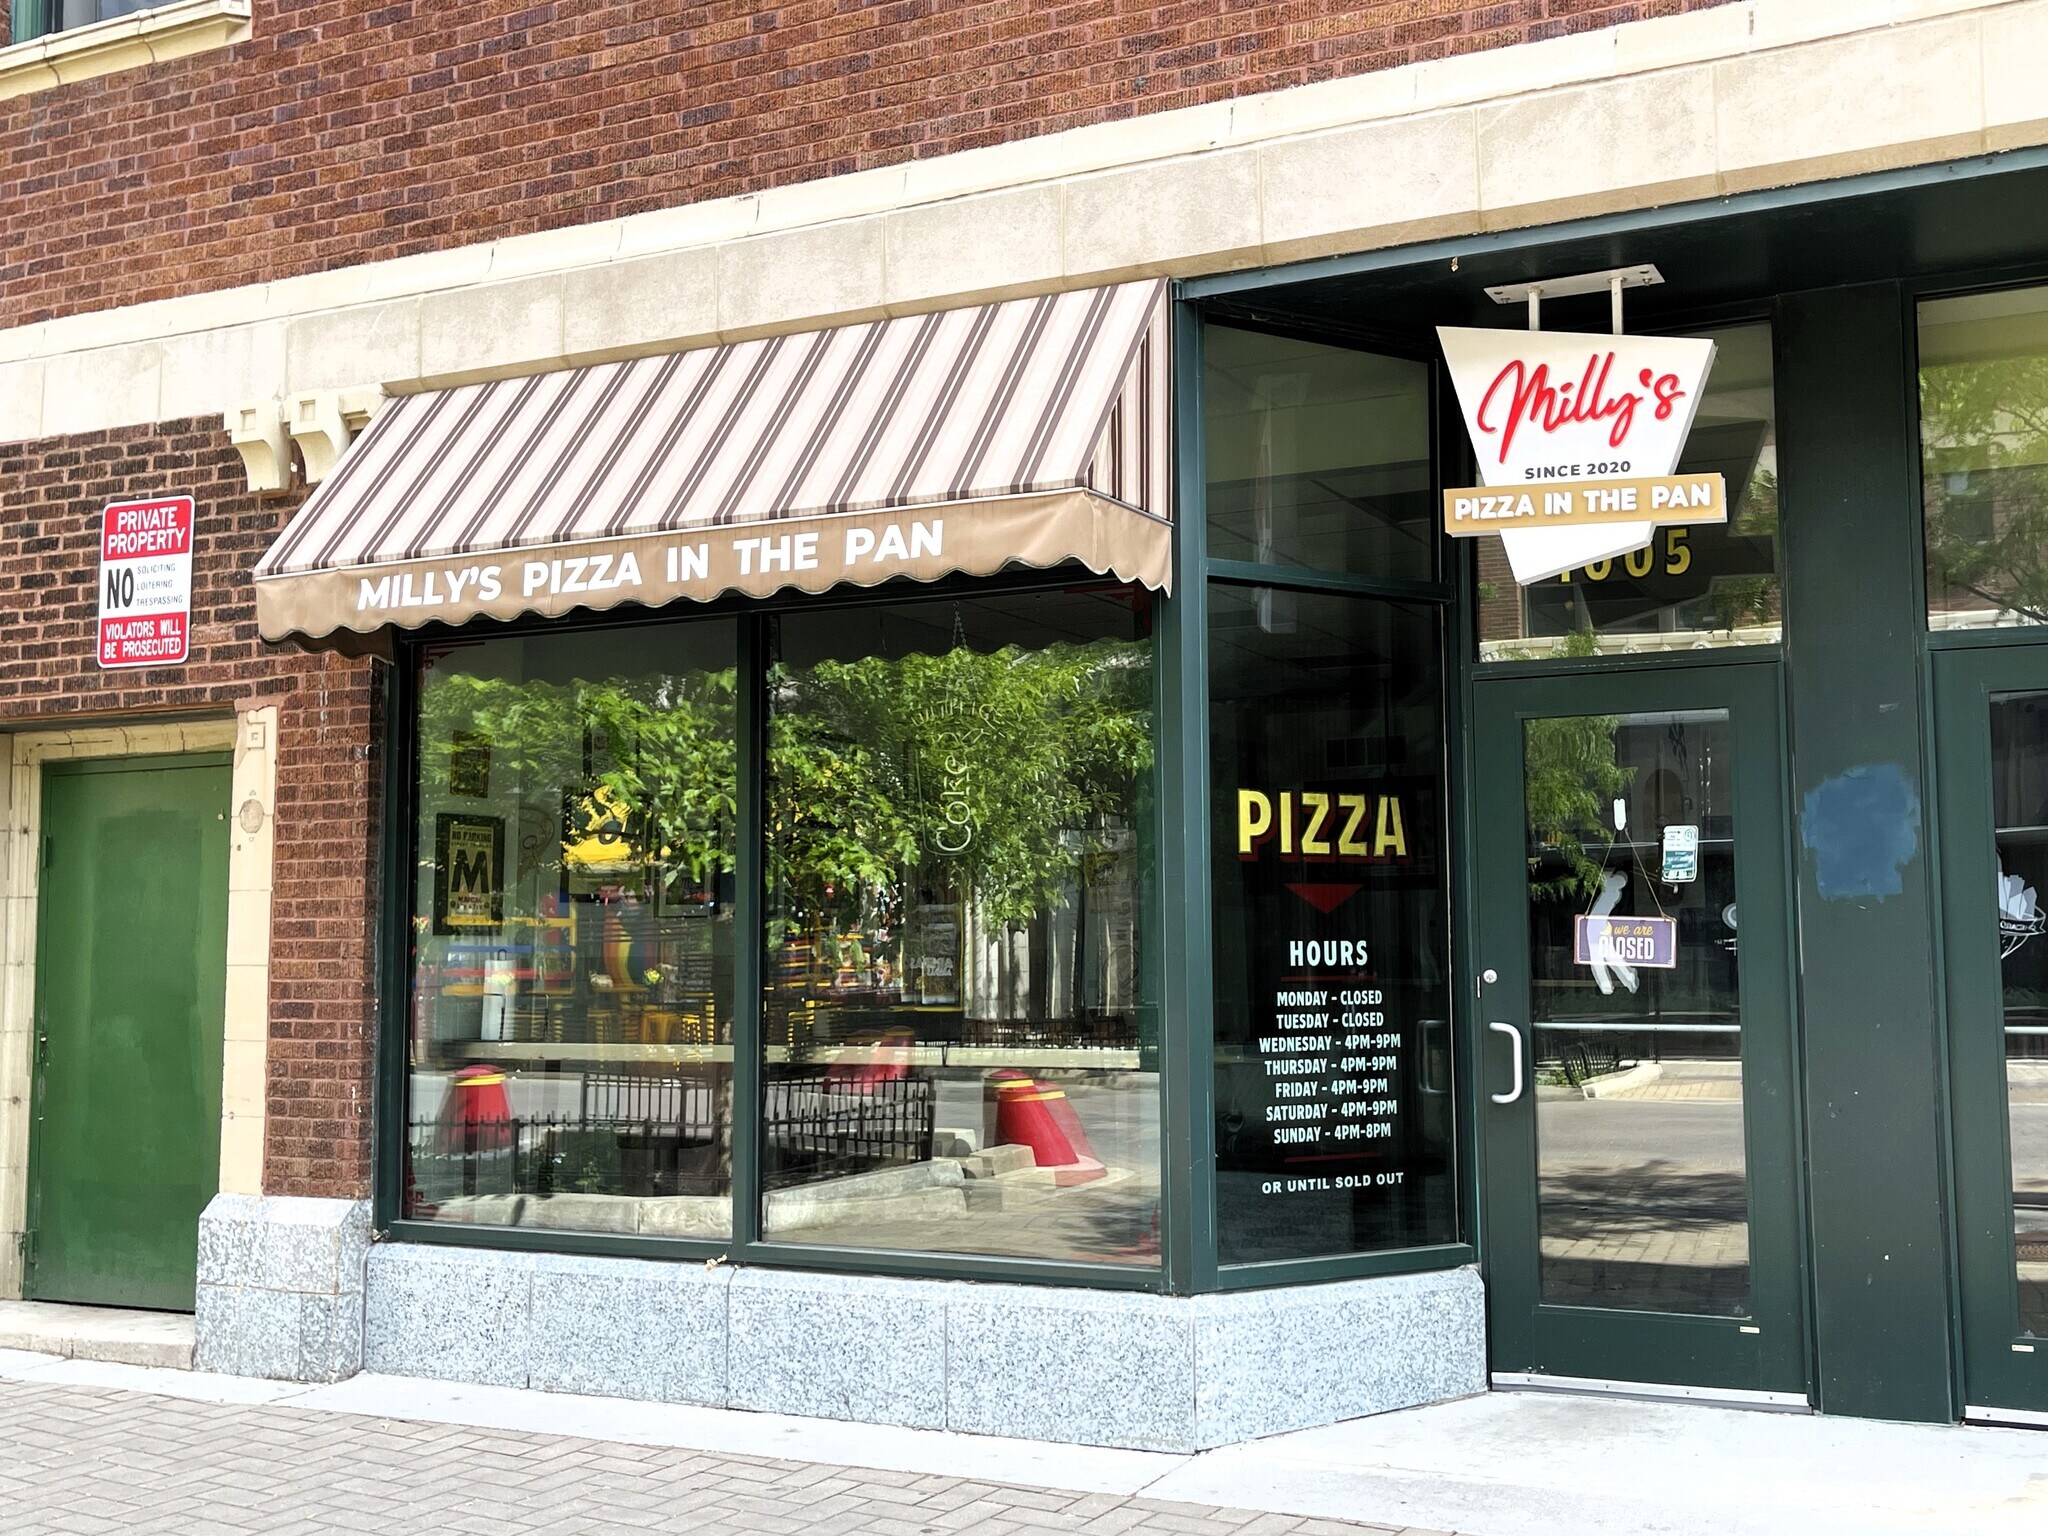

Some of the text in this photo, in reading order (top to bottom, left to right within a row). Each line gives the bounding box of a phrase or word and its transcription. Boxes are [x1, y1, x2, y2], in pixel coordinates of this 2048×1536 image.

[1477, 351, 1687, 465] Milly's
[1524, 460, 1632, 480] SINCE 2020
[1454, 482, 1711, 521] PIZZA IN THE PAN
[117, 506, 178, 533] PRIVATE
[107, 527, 187, 555] PROPERTY
[137, 563, 176, 575] SOLICITING
[356, 519, 945, 612] MILLY'S PIZZA IN THE PAN
[106, 567, 135, 610] NO
[136, 579, 173, 591] LOITERING
[136, 594, 183, 607] TRESPASSING
[105, 618, 182, 640] VIOLATORS WILL
[104, 637, 182, 659] BE PROSECUTED
[1237, 788, 1409, 860] PIZZA
[451, 849, 490, 894] M
[1614, 925, 1654, 936] we are
[1289, 940, 1368, 967] HOURS
[1276, 991, 1328, 1007] MONDAY
[1340, 990, 1383, 1006] CLOSED
[1276, 1013, 1329, 1029] TUESDAY
[1341, 1012, 1384, 1028] CLOSED
[1259, 1035, 1332, 1053] WEDNESDAY
[1344, 1033, 1401, 1050] 4PM-9PM
[1264, 1058, 1328, 1076] THURSDAY
[1340, 1055, 1397, 1072] 4PM-9PM
[1275, 1081, 1318, 1098] FRIDAY
[1330, 1078, 1388, 1095] 4PM-9PM
[1265, 1103, 1328, 1122] SATURDAY
[1340, 1100, 1398, 1117] 4PM-9PM
[1273, 1126, 1321, 1144] SUNDAY
[1334, 1122, 1391, 1140] 4PM-8PM
[1261, 1172, 1404, 1194] OR UNTIL SOLD OUT
